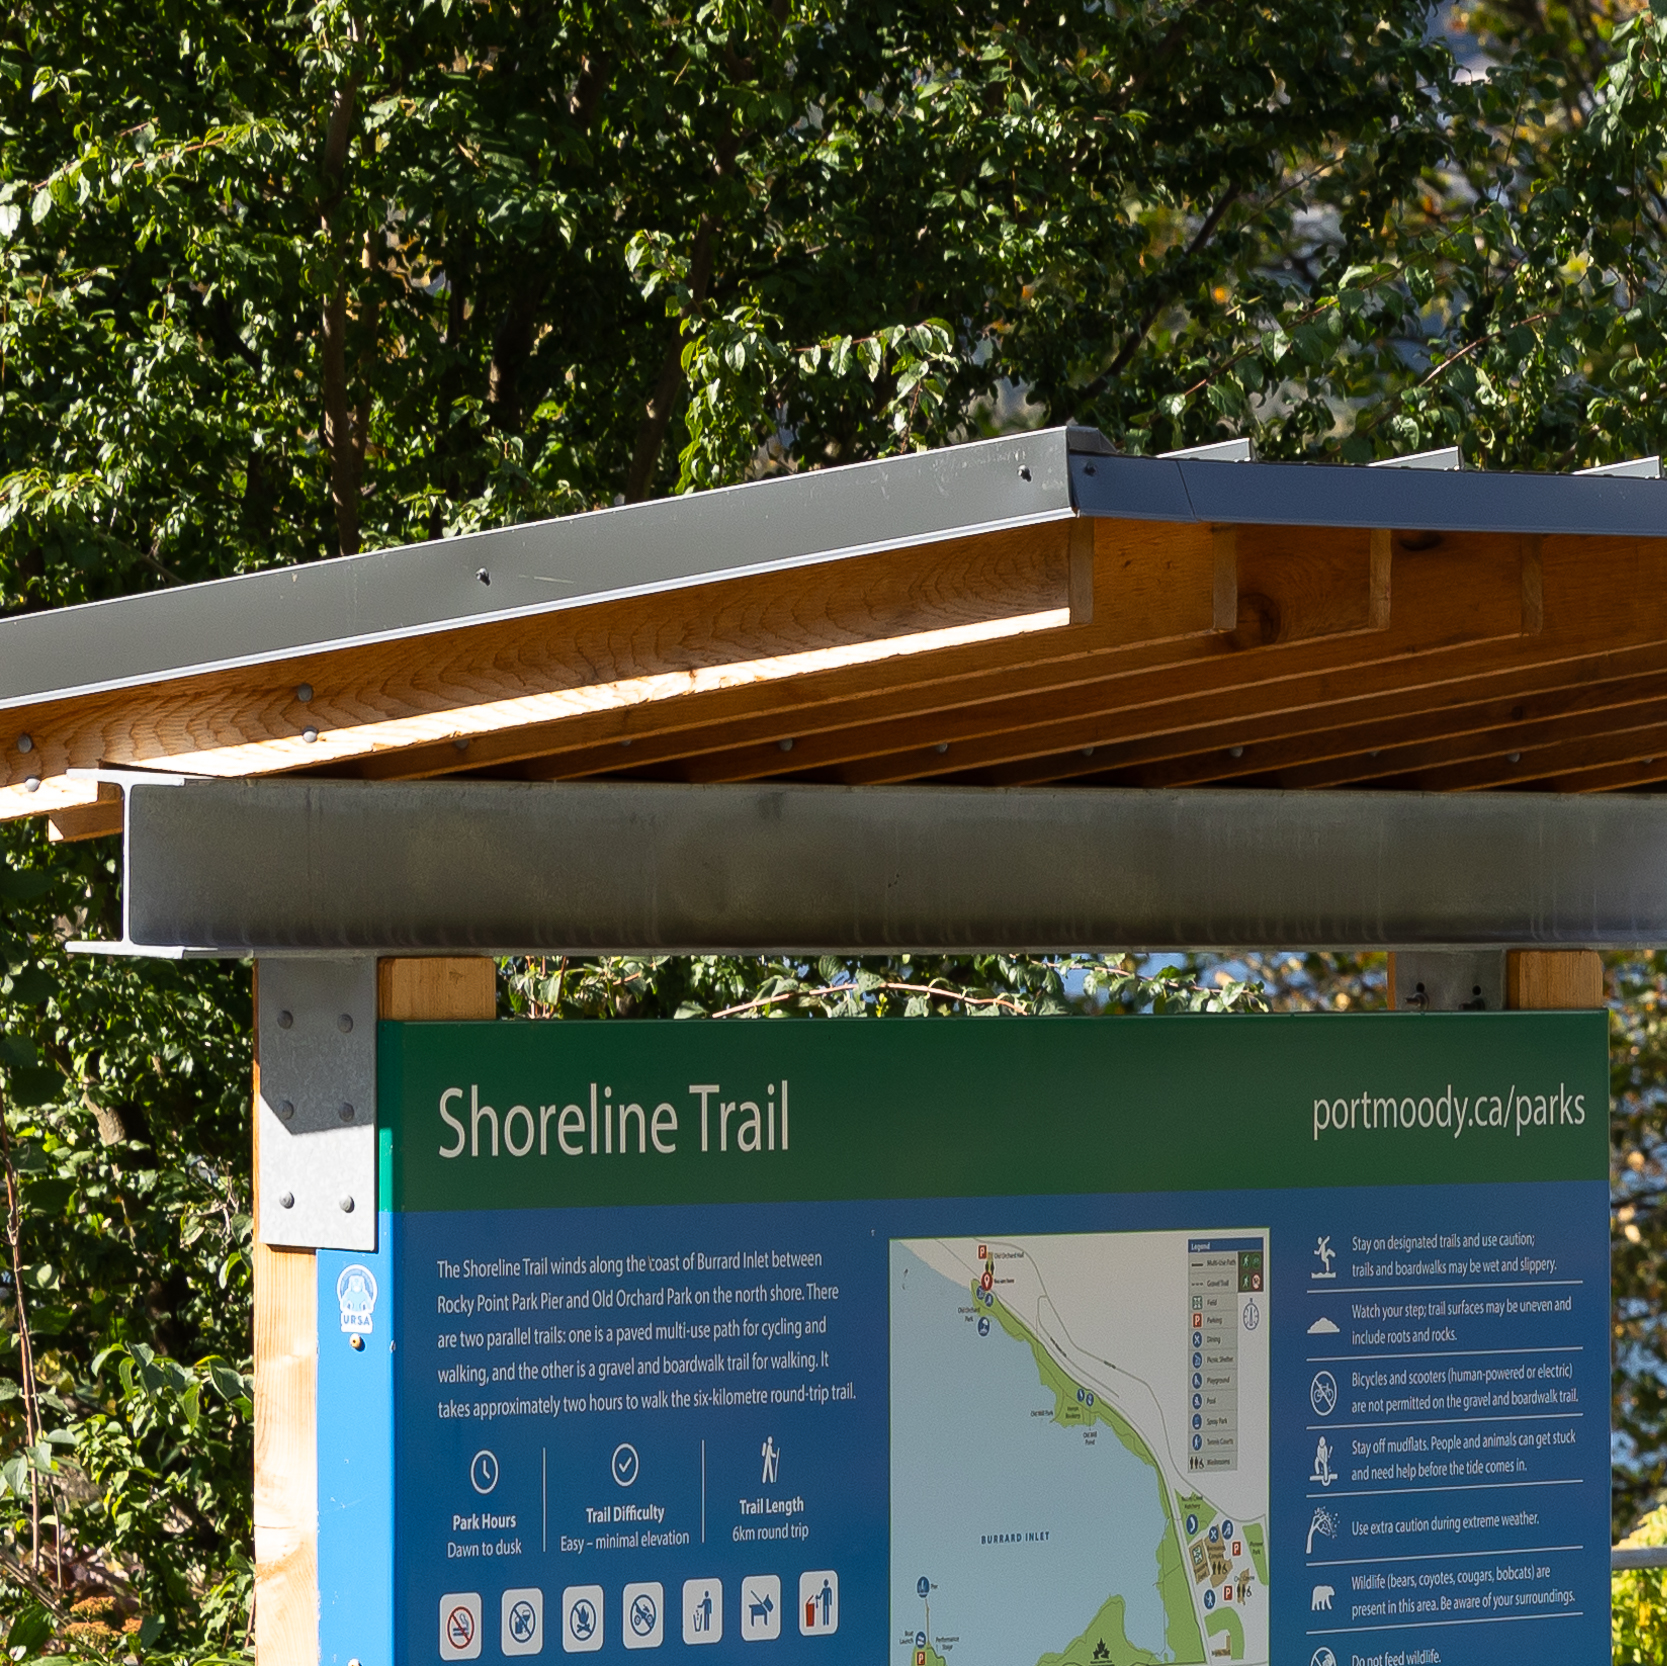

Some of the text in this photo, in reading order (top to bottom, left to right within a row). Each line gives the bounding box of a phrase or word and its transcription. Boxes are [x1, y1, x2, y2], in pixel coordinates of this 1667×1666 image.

[438, 1080, 788, 1158] Shoreline Trail
[1313, 1082, 1585, 1140] portmoody.ca/parks
[1352, 1231, 1535, 1254] Stay on designated trails and use caution;
[436, 1260, 460, 1278] The
[463, 1258, 521, 1278] Shoreline
[522, 1256, 548, 1275] Trail
[550, 1256, 587, 1274] winds
[589, 1255, 623, 1277] along
[626, 1254, 646, 1272] the
[682, 1251, 695, 1271] of
[697, 1251, 740, 1270] Burrard
[743, 1250, 769, 1268] Inlet
[771, 1249, 822, 1268] between
[1352, 1256, 1557, 1277] trails and boardwalks may be wet and slippery.
[437, 1282, 839, 1317] Rocky Point Park Pier and Old Orchard Park on the north shore. There
[343, 1314, 370, 1326] URSA
[437, 1315, 826, 1351] are two parallel trails: one is a paved multi-use path for cycling and
[437, 1350, 829, 1386] walking, and the other is a gravel and boardwalk trail for walking. It
[1351, 1362, 1572, 1390] Bicycles and scooters (human-powered or electric)
[438, 1381, 856, 1420] takes approximately two hours to walk the six-kilometre round-trip trail.
[585, 1503, 664, 1523] Trail Difficulty
[739, 1496, 804, 1516] Trail Length
[453, 1513, 516, 1531] Park Hours
[732, 1521, 809, 1542] 6km round trip
[1351, 1510, 1539, 1536] Use extra caution during extreme weather.
[447, 1537, 522, 1558] Dawn to dusk
[560, 1535, 584, 1554] Easy
[595, 1531, 638, 1549] minimal
[640, 1529, 689, 1547] elevation
[981, 1531, 1050, 1544] BURRARD INLET
[1351, 1564, 1550, 1590] Wildlife (bears, coyotes, cougars, bobcats) are
[1384, 1650, 1404, 1666] feed
[1405, 1648, 1441, 1665] wildlife.
